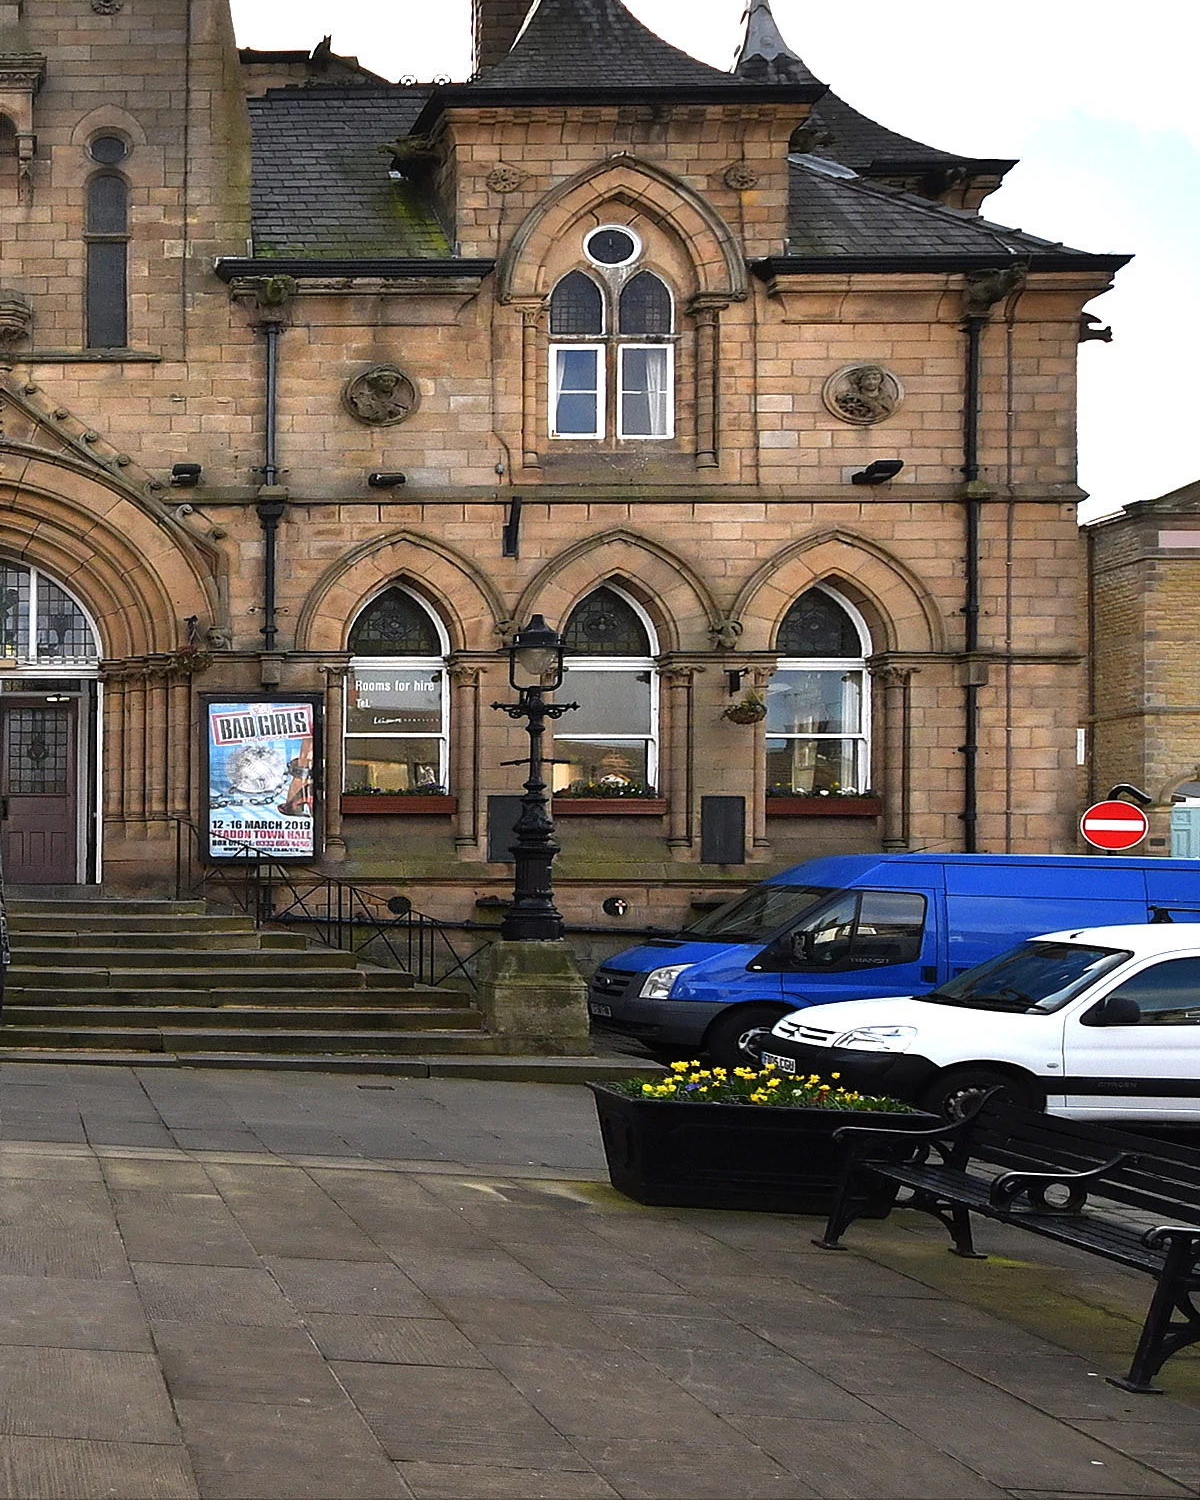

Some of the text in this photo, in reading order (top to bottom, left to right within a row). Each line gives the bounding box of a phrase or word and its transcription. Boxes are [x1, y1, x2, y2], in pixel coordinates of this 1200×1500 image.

[355, 679, 435, 692] Rooms for hire
[219, 712, 307, 740] BAD GIRLS
[212, 820, 224, 829] 12
[245, 820, 282, 830] MARCH
[285, 820, 311, 830] 2019
[211, 829, 312, 839] YEADON TOWN HALL
[212, 839, 227, 847] BOX
